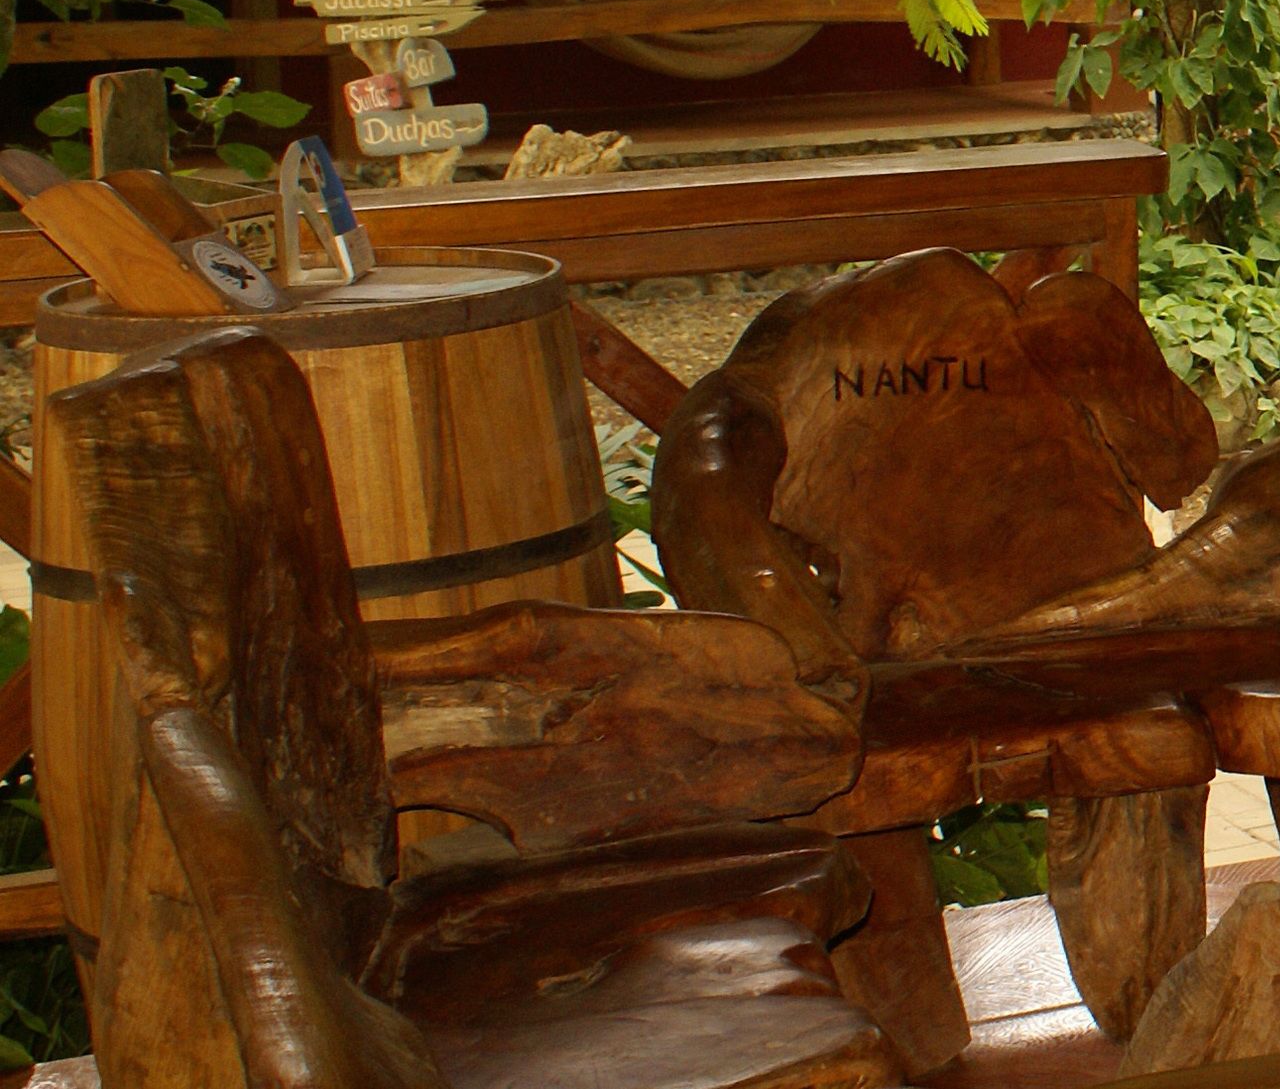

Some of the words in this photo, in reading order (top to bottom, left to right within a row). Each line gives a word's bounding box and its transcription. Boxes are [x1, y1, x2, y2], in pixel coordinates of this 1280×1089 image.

[336, 23, 409, 42] Piscina
[404, 49, 436, 81] Bar
[350, 82, 390, 114] Suites
[363, 113, 455, 147] Duchas
[833, 356, 989, 401] NANTU
